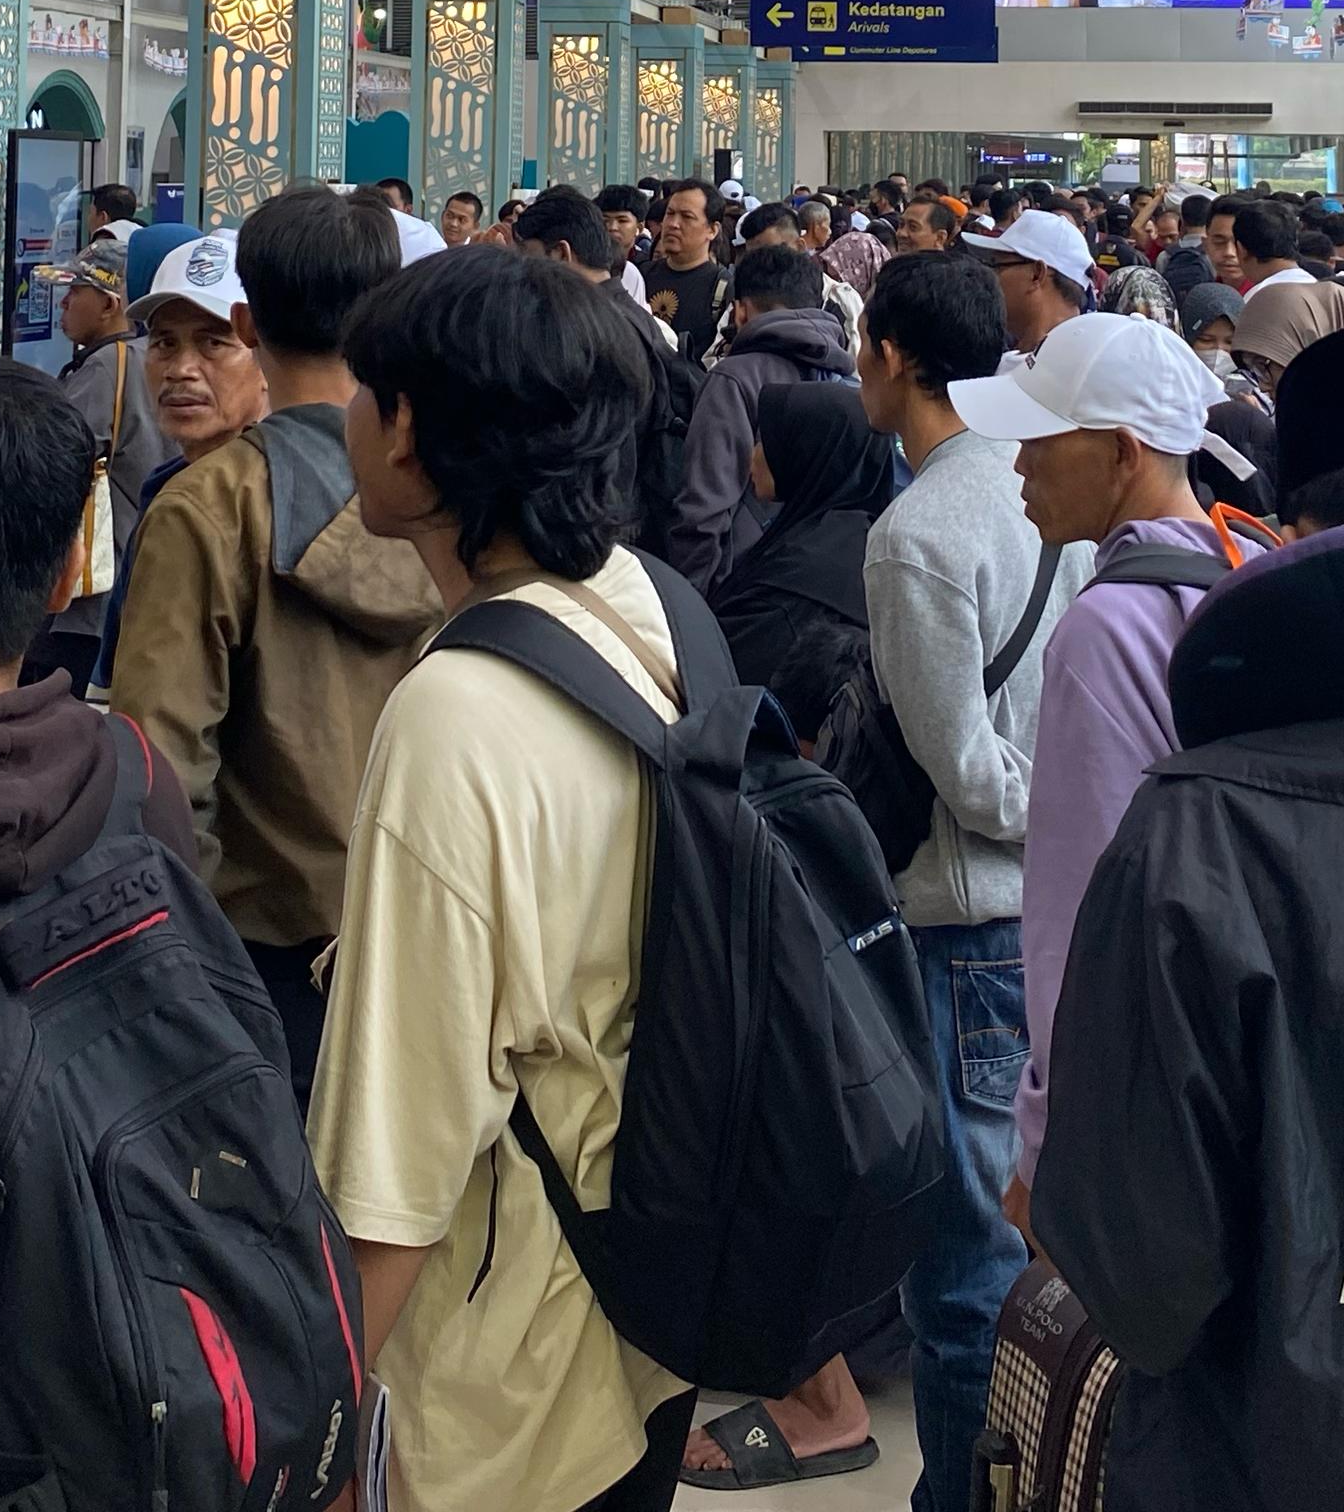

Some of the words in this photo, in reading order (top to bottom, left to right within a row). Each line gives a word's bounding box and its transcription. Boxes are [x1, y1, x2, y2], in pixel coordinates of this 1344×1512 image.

[848, 1, 945, 20] Kedatangan
[848, 21, 891, 34] Arivals
[1020, 1315, 1047, 1343] TEAM
